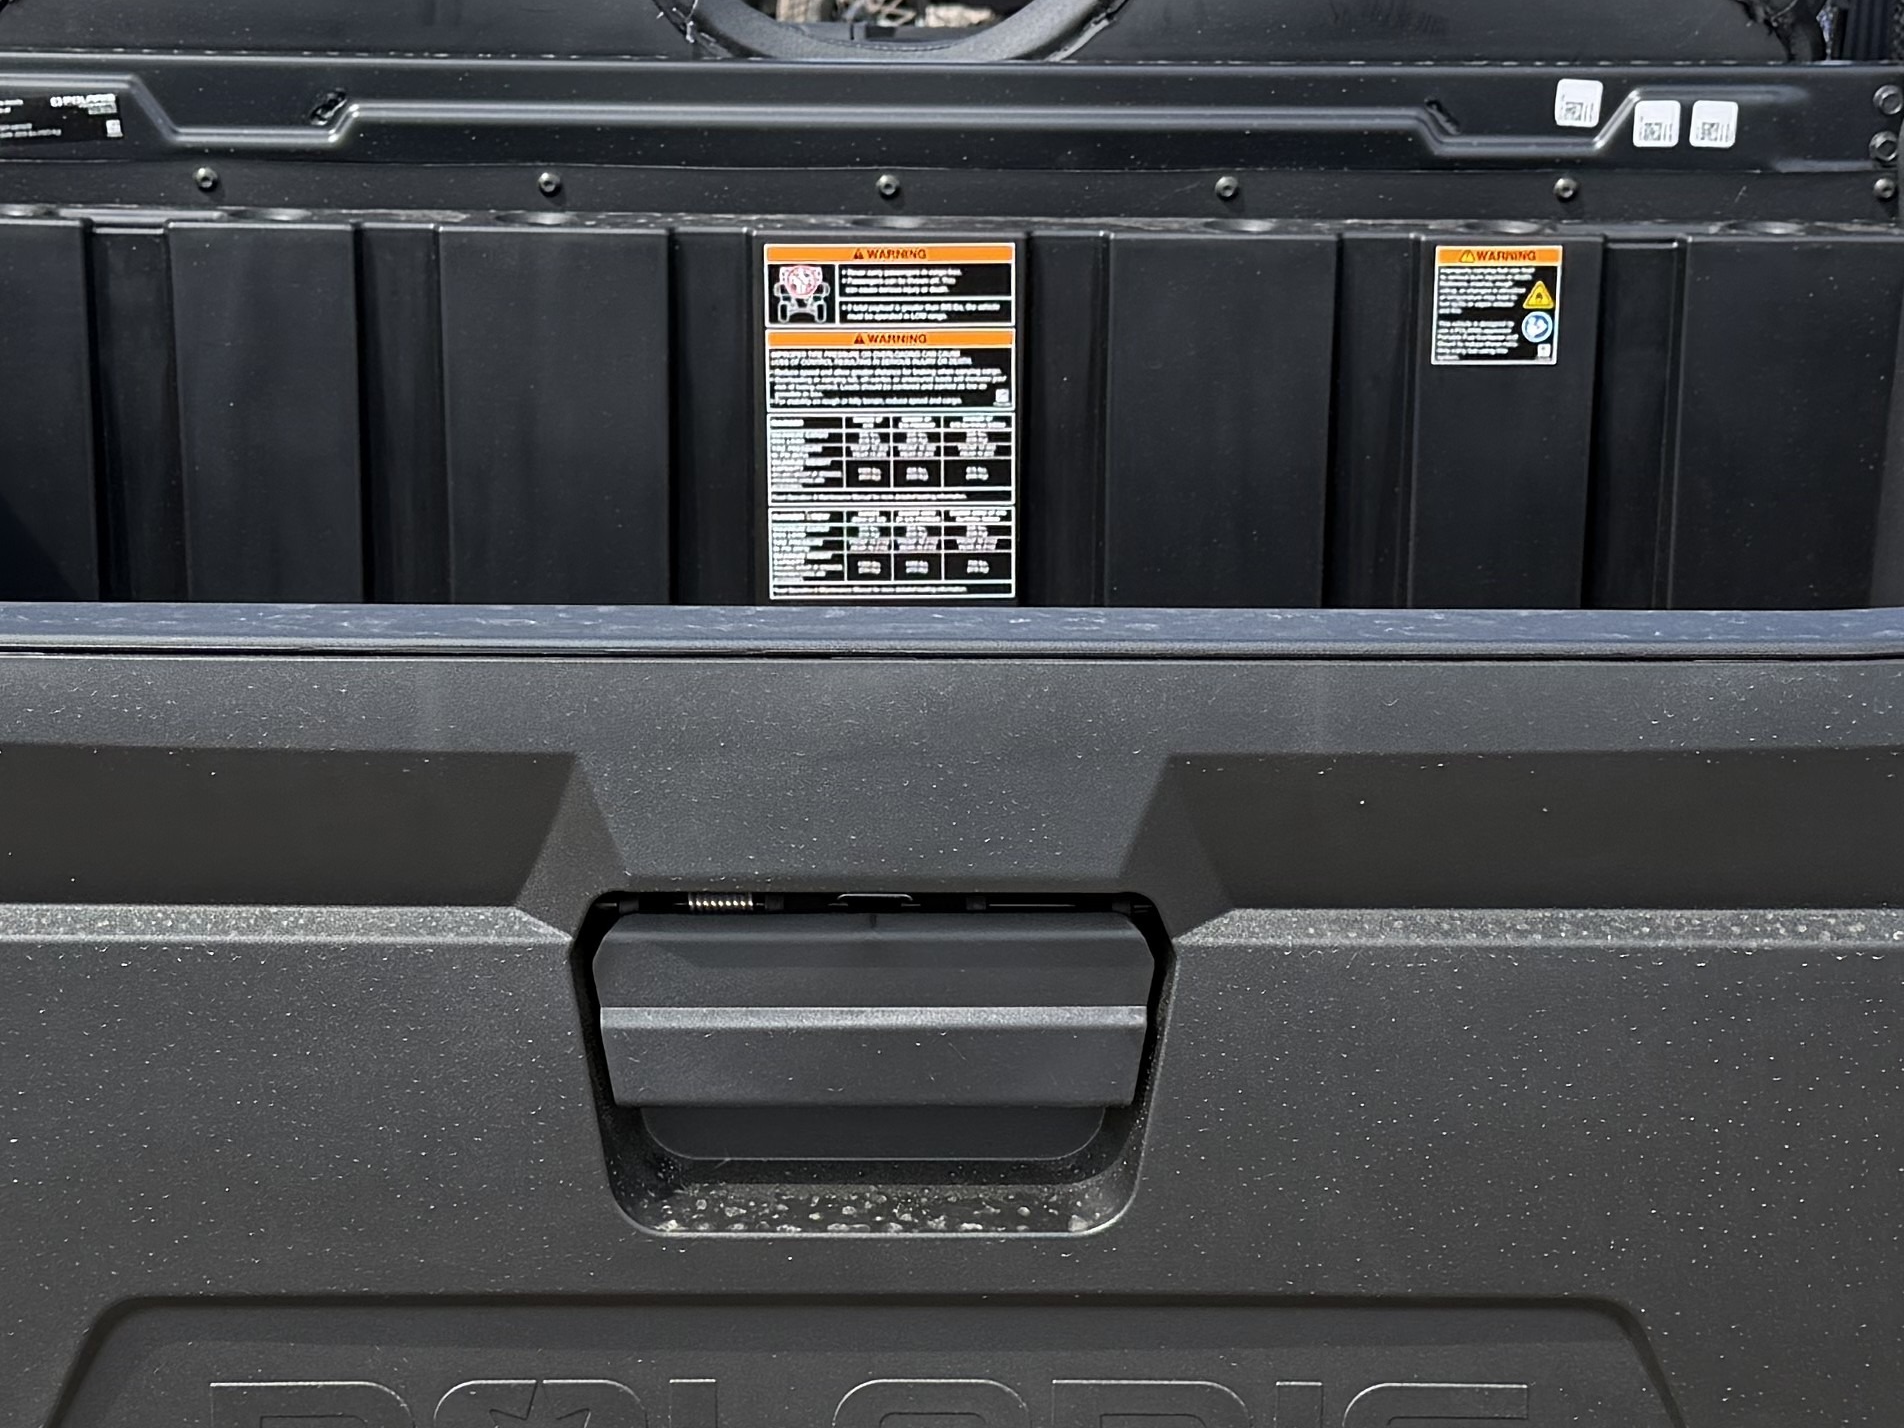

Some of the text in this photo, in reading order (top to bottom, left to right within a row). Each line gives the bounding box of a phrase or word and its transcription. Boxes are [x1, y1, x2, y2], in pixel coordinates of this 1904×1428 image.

[867, 248, 927, 260] WARNING
[1476, 250, 1537, 262] WARNING
[867, 333, 928, 345] WARNING
